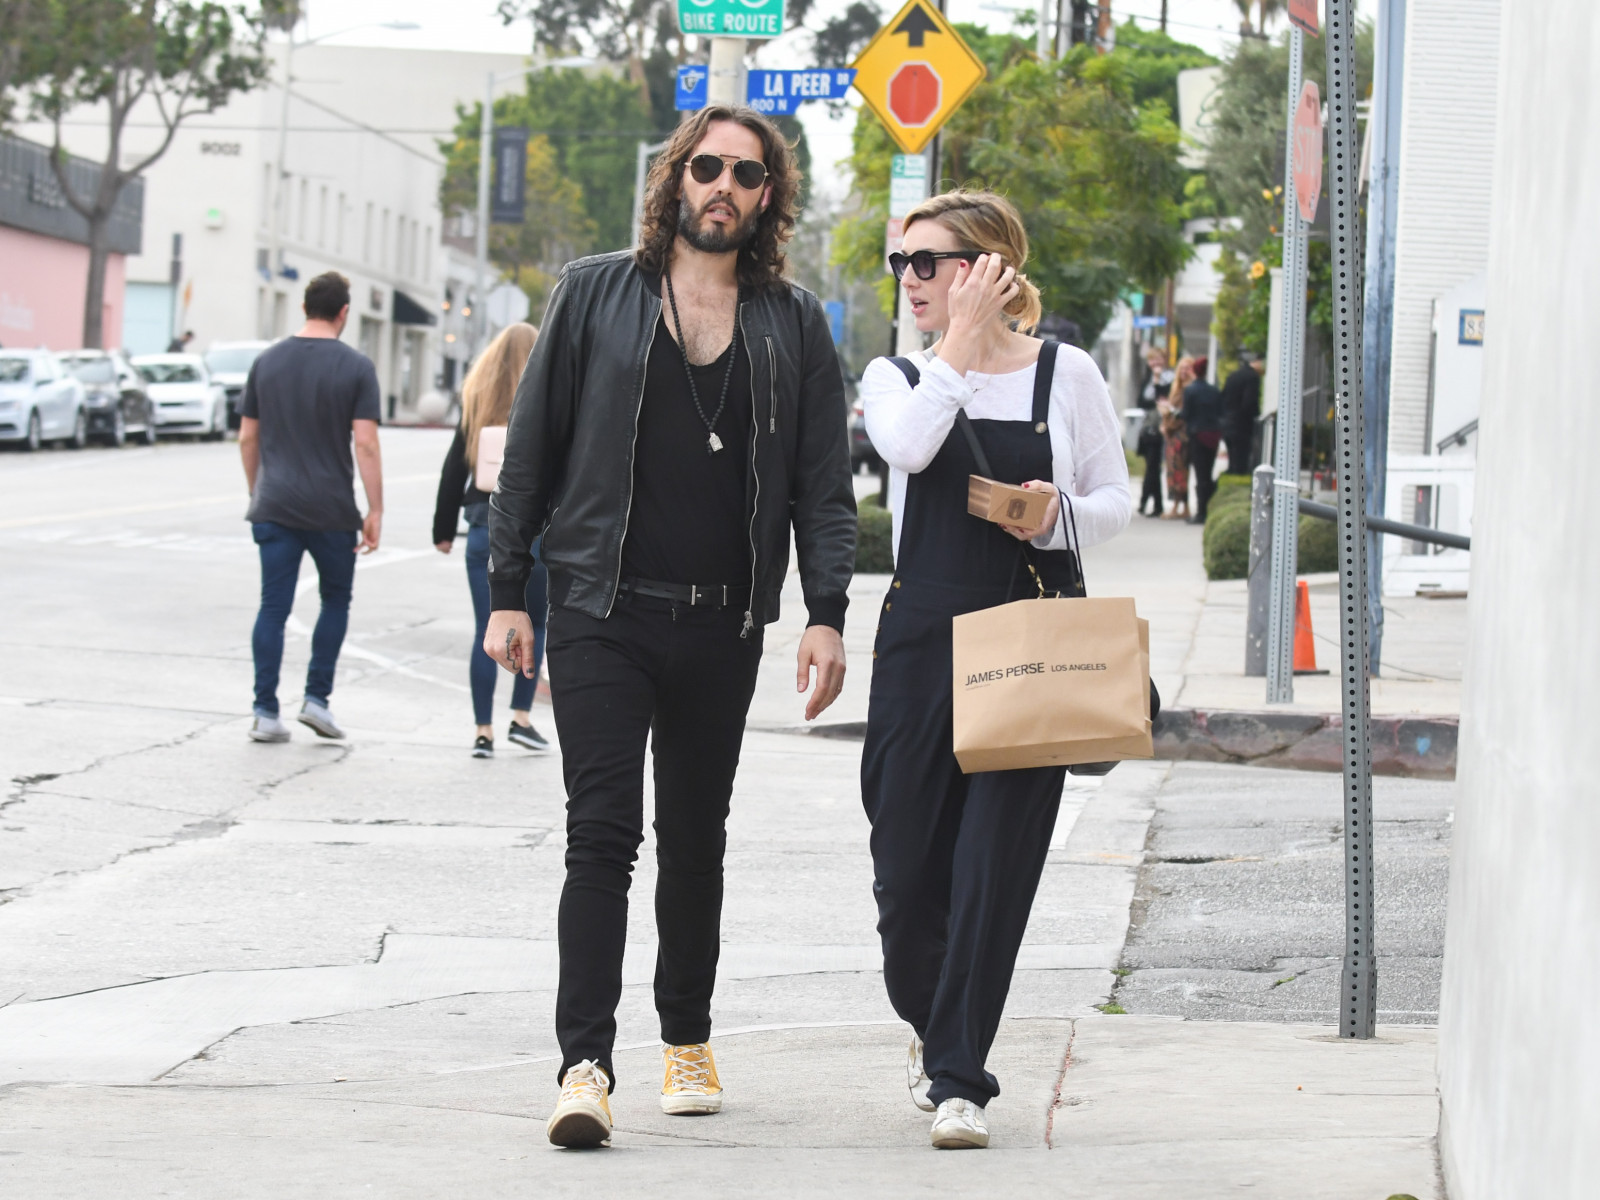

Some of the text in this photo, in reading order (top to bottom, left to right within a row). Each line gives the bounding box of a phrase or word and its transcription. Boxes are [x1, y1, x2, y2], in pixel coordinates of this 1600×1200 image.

[683, 12, 778, 33] BIKE ROUTE
[764, 72, 849, 97] LA PEER DR
[778, 98, 788, 112] N
[965, 662, 1107, 686] JAMES PERSE LOS ANGELES
